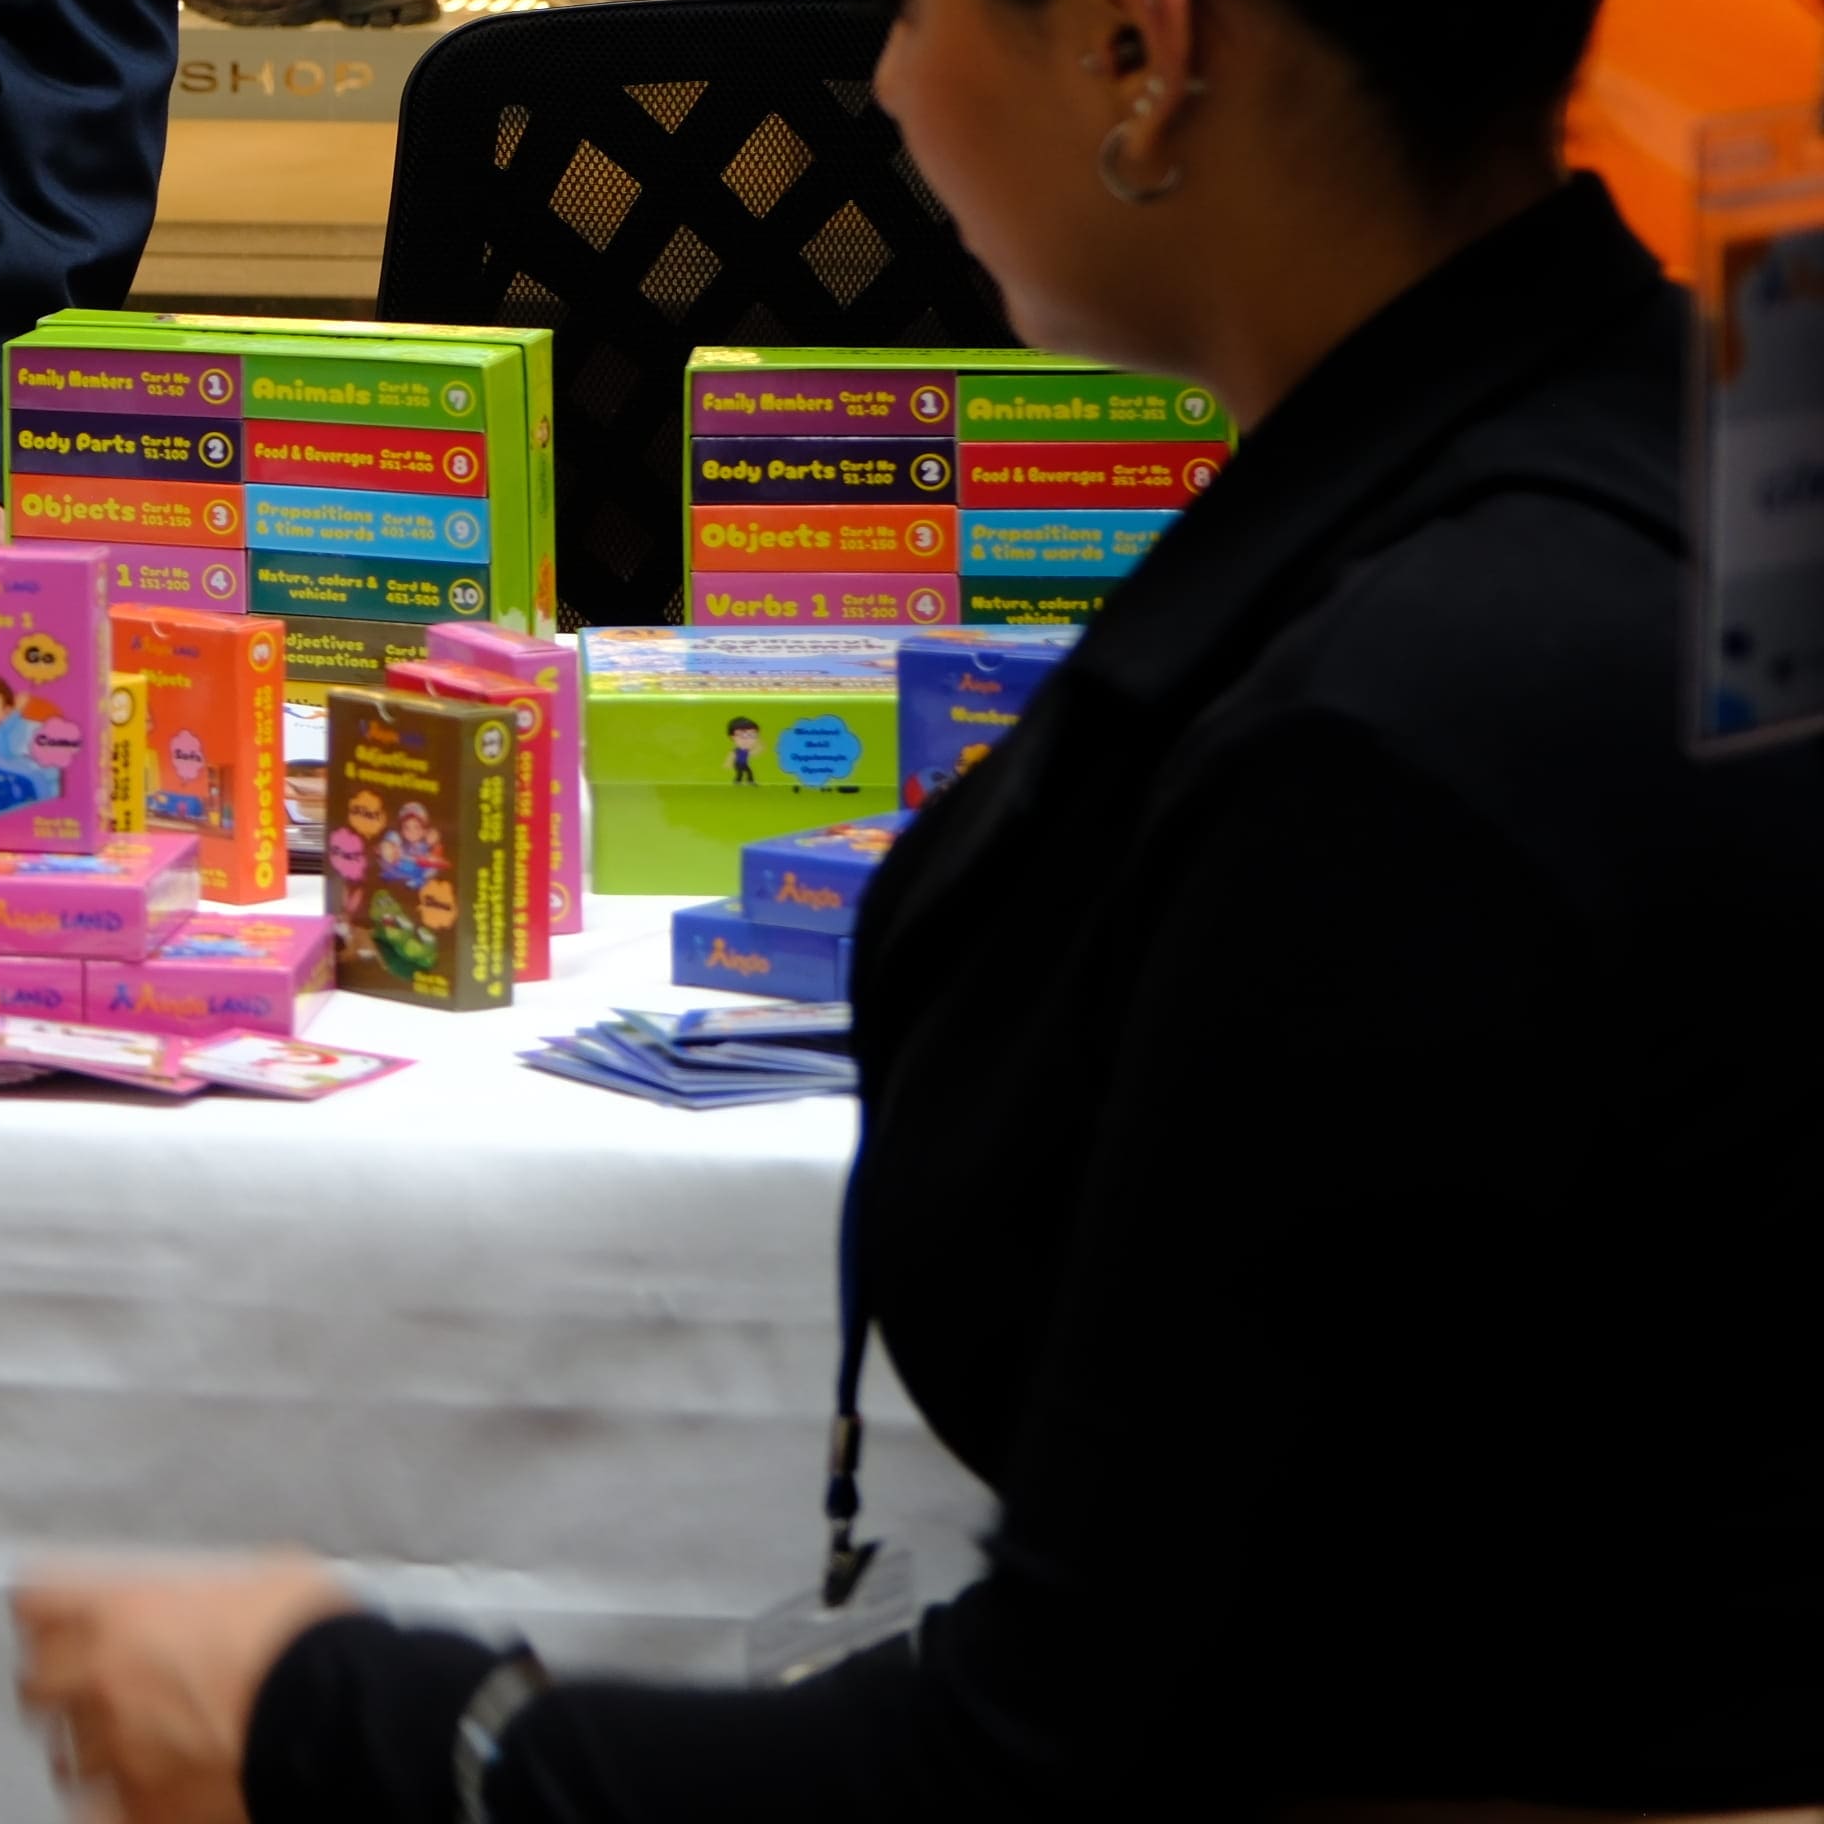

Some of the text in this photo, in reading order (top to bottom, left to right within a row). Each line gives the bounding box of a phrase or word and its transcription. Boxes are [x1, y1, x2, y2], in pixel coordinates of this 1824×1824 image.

[180, 62, 374, 96] SHOP
[18, 368, 133, 390] Family Members
[141, 372, 190, 385] Card No
[208, 374, 223, 396] 1
[378, 381, 429, 394] Card No
[147, 385, 185, 397] 01-50
[253, 377, 371, 406] Animals
[448, 389, 467, 411] 7
[839, 391, 896, 404] Card No
[703, 392, 833, 414] Family Members
[847, 404, 889, 416] 01-50
[920, 392, 938, 414] 1
[966, 397, 1101, 421] Animals
[1109, 395, 1166, 408] Card No
[1185, 397, 1205, 419] 7
[18, 430, 136, 454] Body Parts
[141, 435, 191, 448] Card No
[207, 438, 224, 459] 2
[144, 449, 189, 461] 51-100
[254, 443, 373, 467] Food & Beverages
[380, 448, 432, 461] Card No
[379, 460, 434, 473] 351-400
[452, 455, 468, 476] 8
[702, 459, 837, 484] Body Parts
[840, 460, 896, 472] Card No
[921, 460, 940, 482] 2
[1112, 465, 1170, 475] Card No
[843, 473, 894, 485] 51-100
[971, 467, 1104, 486] Food & Beverages
[1194, 466, 1211, 488] 8
[21, 493, 136, 524] Objects
[141, 502, 191, 515] Card No
[212, 505, 228, 526] 3
[141, 514, 192, 527] 101-150
[382, 513, 433, 526] Card No
[256, 521, 374, 542] & time words
[455, 520, 470, 539] 9
[701, 522, 831, 554] Objects
[840, 526, 896, 538] Card No
[915, 526, 933, 547] 3
[839, 538, 897, 551] 101-150
[992, 544, 1036, 561] time
[1042, 544, 1104, 561] words
[117, 564, 132, 588] 1
[140, 566, 190, 578] Card No
[210, 570, 227, 591] 4
[258, 569, 378, 589] Nature, colors &
[289, 587, 347, 602] vehicles
[387, 580, 439, 594] Card No
[453, 587, 478, 605] 10
[386, 593, 440, 606] 451-500
[705, 593, 830, 618] Verbs 1
[842, 594, 896, 606] Card No
[916, 594, 935, 616] 4
[1038, 597, 1089, 611] colors
[283, 633, 364, 652] djectives
[385, 644, 415, 656] Card
[25, 646, 55, 665] Go
[283, 653, 378, 669] ccupations
[254, 751, 277, 889] Objects
